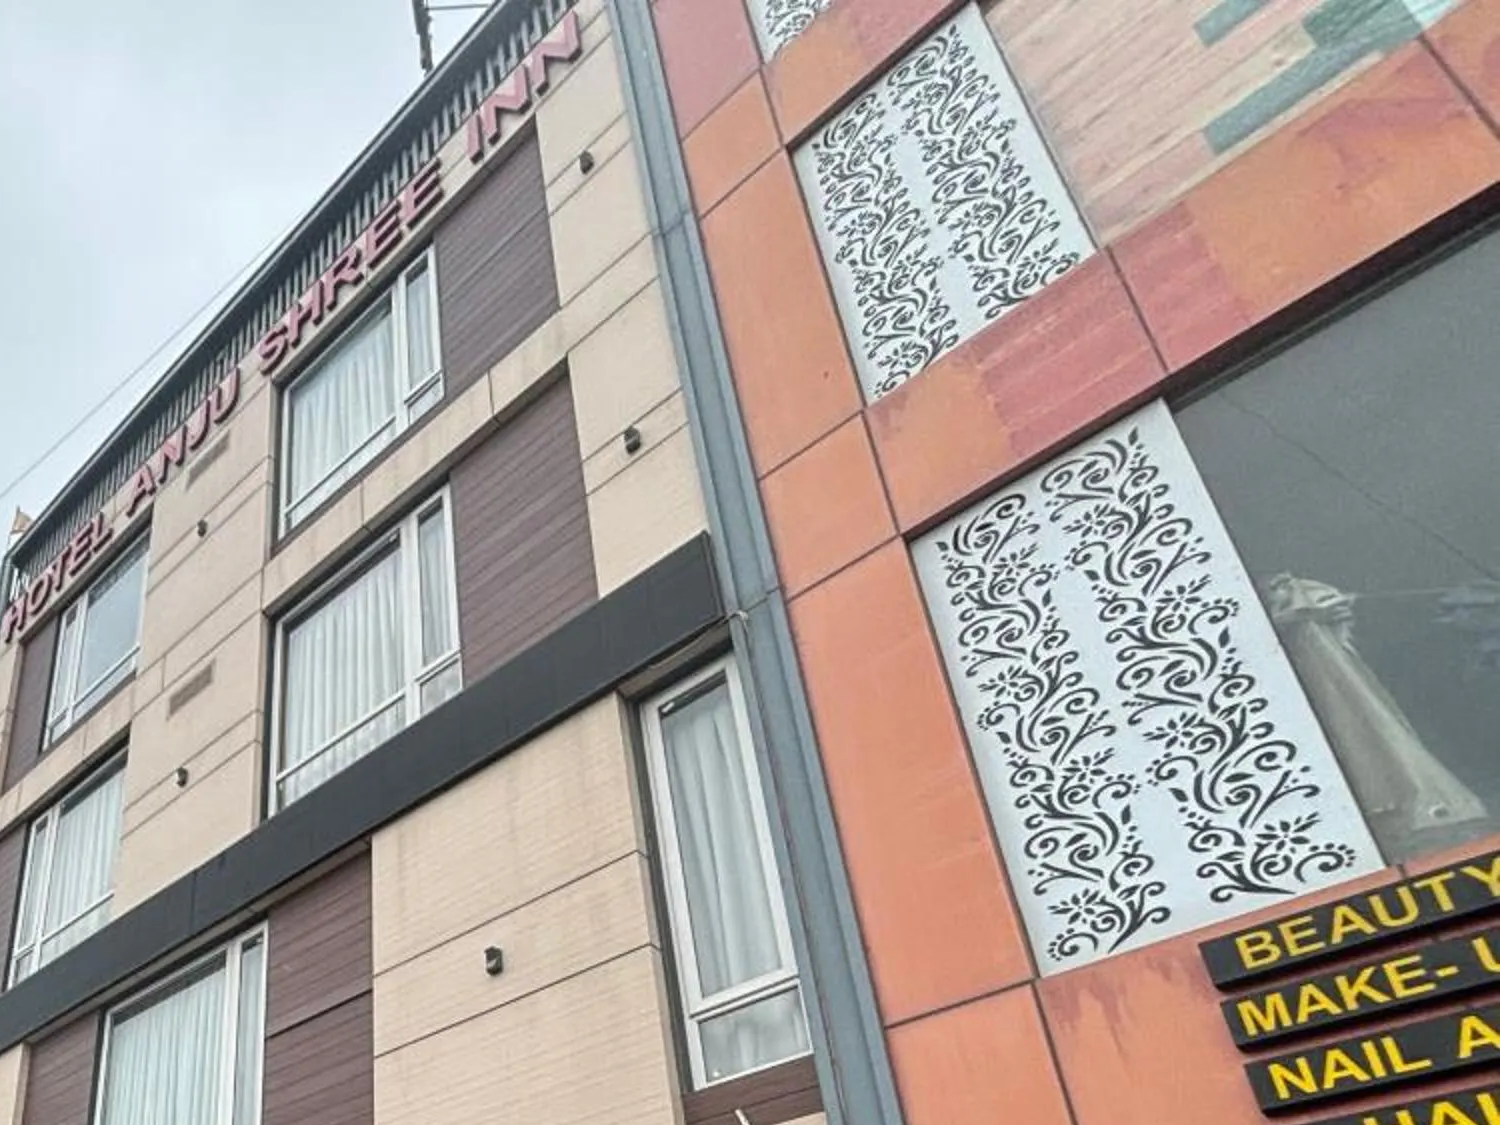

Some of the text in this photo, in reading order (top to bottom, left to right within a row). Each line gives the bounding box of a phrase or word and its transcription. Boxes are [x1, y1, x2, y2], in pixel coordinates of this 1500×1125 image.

[2, 9, 582, 643] HOTEL ANJU SHREE INN
[1235, 856, 1500, 970] BEAUTY
[1268, 1036, 1432, 1100] NAIL
